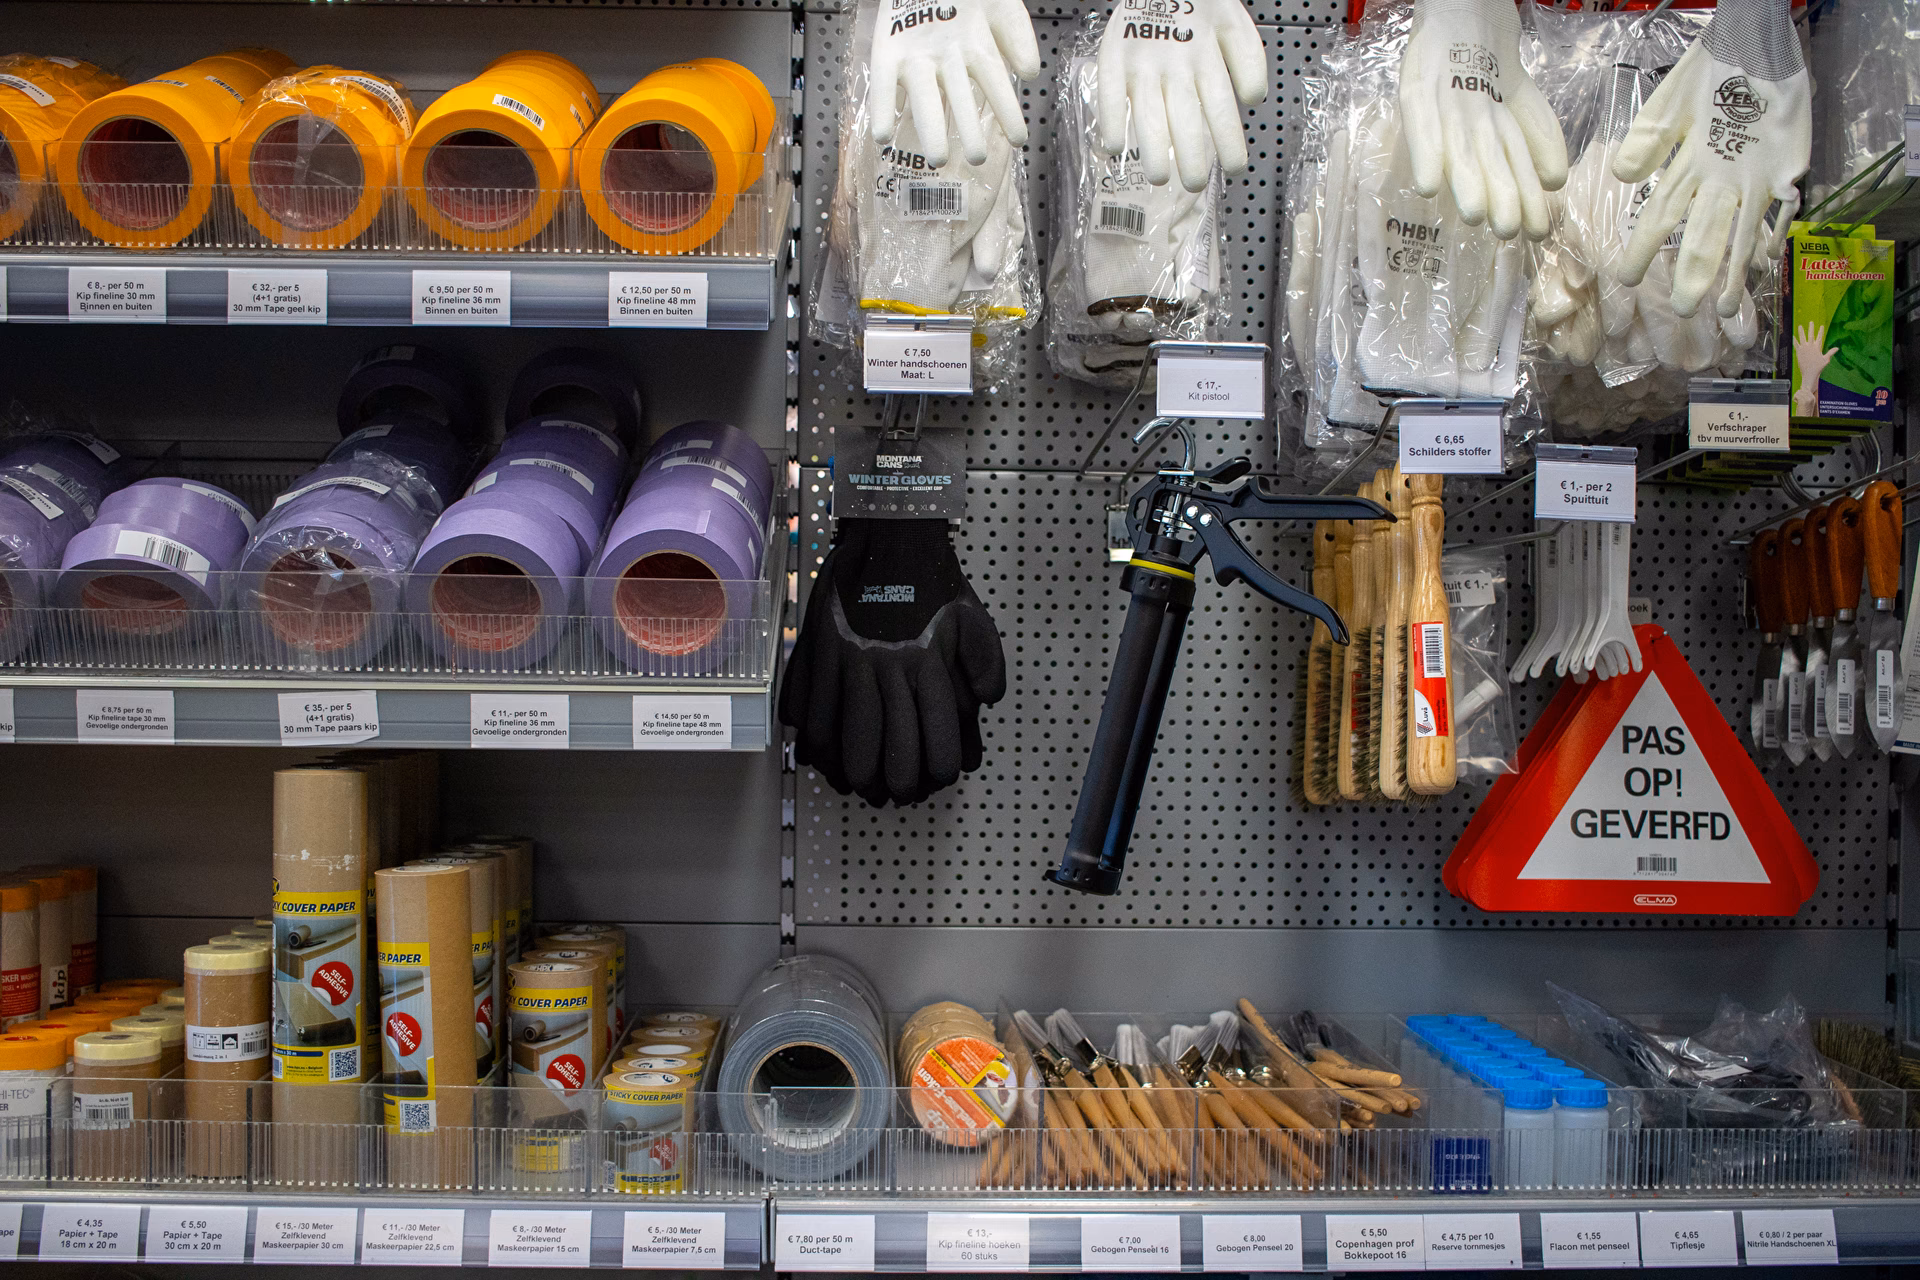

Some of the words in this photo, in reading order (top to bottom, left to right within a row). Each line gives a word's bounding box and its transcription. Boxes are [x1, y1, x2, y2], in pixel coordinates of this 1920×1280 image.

[891, 10, 933, 36] HBV
[1124, 23, 1170, 40] HBV
[1451, 75, 1490, 96] HBV
[1720, 92, 1761, 111] VEBA
[1711, 118, 1748, 131] PU-SOFT
[1402, 222, 1440, 243] HBV
[1800, 242, 1830, 251] VEBA
[1800, 257, 1847, 271] Latex
[1806, 270, 1885, 280] handschoenen
[76, 291, 91, 301] Kip
[93, 291, 124, 299] fineline
[252, 294, 270, 304] (4+1
[273, 294, 301, 303] gratis)
[79, 302, 110, 312] Binnen
[125, 302, 152, 310] buiten
[264, 304, 284, 313] Tape
[286, 305, 305, 314] geel
[307, 305, 320, 314] kip
[912, 348, 930, 357] 7,50
[867, 358, 897, 367] Winter
[900, 359, 967, 368] handschoenen
[900, 370, 925, 378] Maat:
[1205, 381, 1221, 390] 17,-
[1188, 392, 1199, 400] Kit
[1202, 392, 1229, 401] pistool
[1875, 390, 1888, 399] 10
[1737, 412, 1748, 421] 1,-
[1707, 422, 1766, 433] Verfschraper
[1443, 435, 1464, 445] 6,65
[1697, 434, 1711, 442] tbv
[1714, 435, 1780, 443] muurverfroller
[1409, 447, 1455, 456] Schilders
[1458, 446, 1491, 456] stoffer
[849, 474, 899, 485] WINTER
[901, 474, 952, 485] GLOVES
[1570, 480, 1582, 491] 1,-
[1585, 483, 1603, 492] per
[1563, 494, 1608, 505] Spuittuit
[884, 586, 915, 594] CANS
[862, 594, 915, 603] MONTANA
[305, 714, 323, 723] (4+1
[326, 713, 354, 723] gratis)
[85, 722, 119, 730] Gevoelige
[120, 723, 168, 731] ondergronden
[314, 724, 335, 733] Tape
[338, 724, 362, 732] paars
[364, 721, 379, 731] kip
[642, 721, 654, 730] Kip
[682, 721, 697, 730] tape
[1622, 725, 1685, 755] PAS
[1624, 766, 1681, 797] OP!
[1570, 809, 1730, 839] GEVERFD
[282, 902, 317, 913] COVER
[319, 902, 356, 913] PAPER
[387, 953, 421, 963] PAPER
[330, 968, 347, 986] SELF-
[53, 969, 66, 1000] kip
[318, 969, 349, 998] ADHESIVE
[518, 997, 552, 1008] COVER
[554, 996, 588, 1008] PAPER
[397, 1019, 413, 1038] SELF-
[389, 1018, 416, 1051] ADHESIVE
[564, 1061, 580, 1077] SELF-
[552, 1061, 582, 1089] ADHESIVE
[609, 1090, 631, 1099] STICKY
[633, 1093, 660, 1101] COVER
[660, 1092, 684, 1101] PAPER
[58, 1229, 87, 1238] Papier
[97, 1230, 118, 1239] Tape
[280, 1231, 326, 1239] Zelfklevend
[387, 1233, 433, 1241] Zelfklevend
[262, 1241, 319, 1250] Maskeerpapier
[365, 1242, 422, 1251] Maskeerpapier
[424, 1243, 440, 1251] 22,5
[497, 1244, 554, 1253] Maskeerpapier
[631, 1245, 689, 1254] Maskeerpapier
[690, 1246, 702, 1254] 7,5
[938, 1239, 952, 1250] Kip
[955, 1239, 986, 1248] fineline
[988, 1241, 1020, 1249] hoeken
[1090, 1245, 1125, 1254] Gebogen
[1127, 1244, 1158, 1253] Penseel
[1216, 1244, 1250, 1253] Gebogen
[1549, 1242, 1577, 1250] Flacon
[1597, 1242, 1629, 1251] penseel
[1670, 1241, 1705, 1250] Tipflesje
[799, 1245, 841, 1255] Duct-tape
[974, 1252, 997, 1260] stuks
[1344, 1251, 1393, 1261] Bokkepoot
